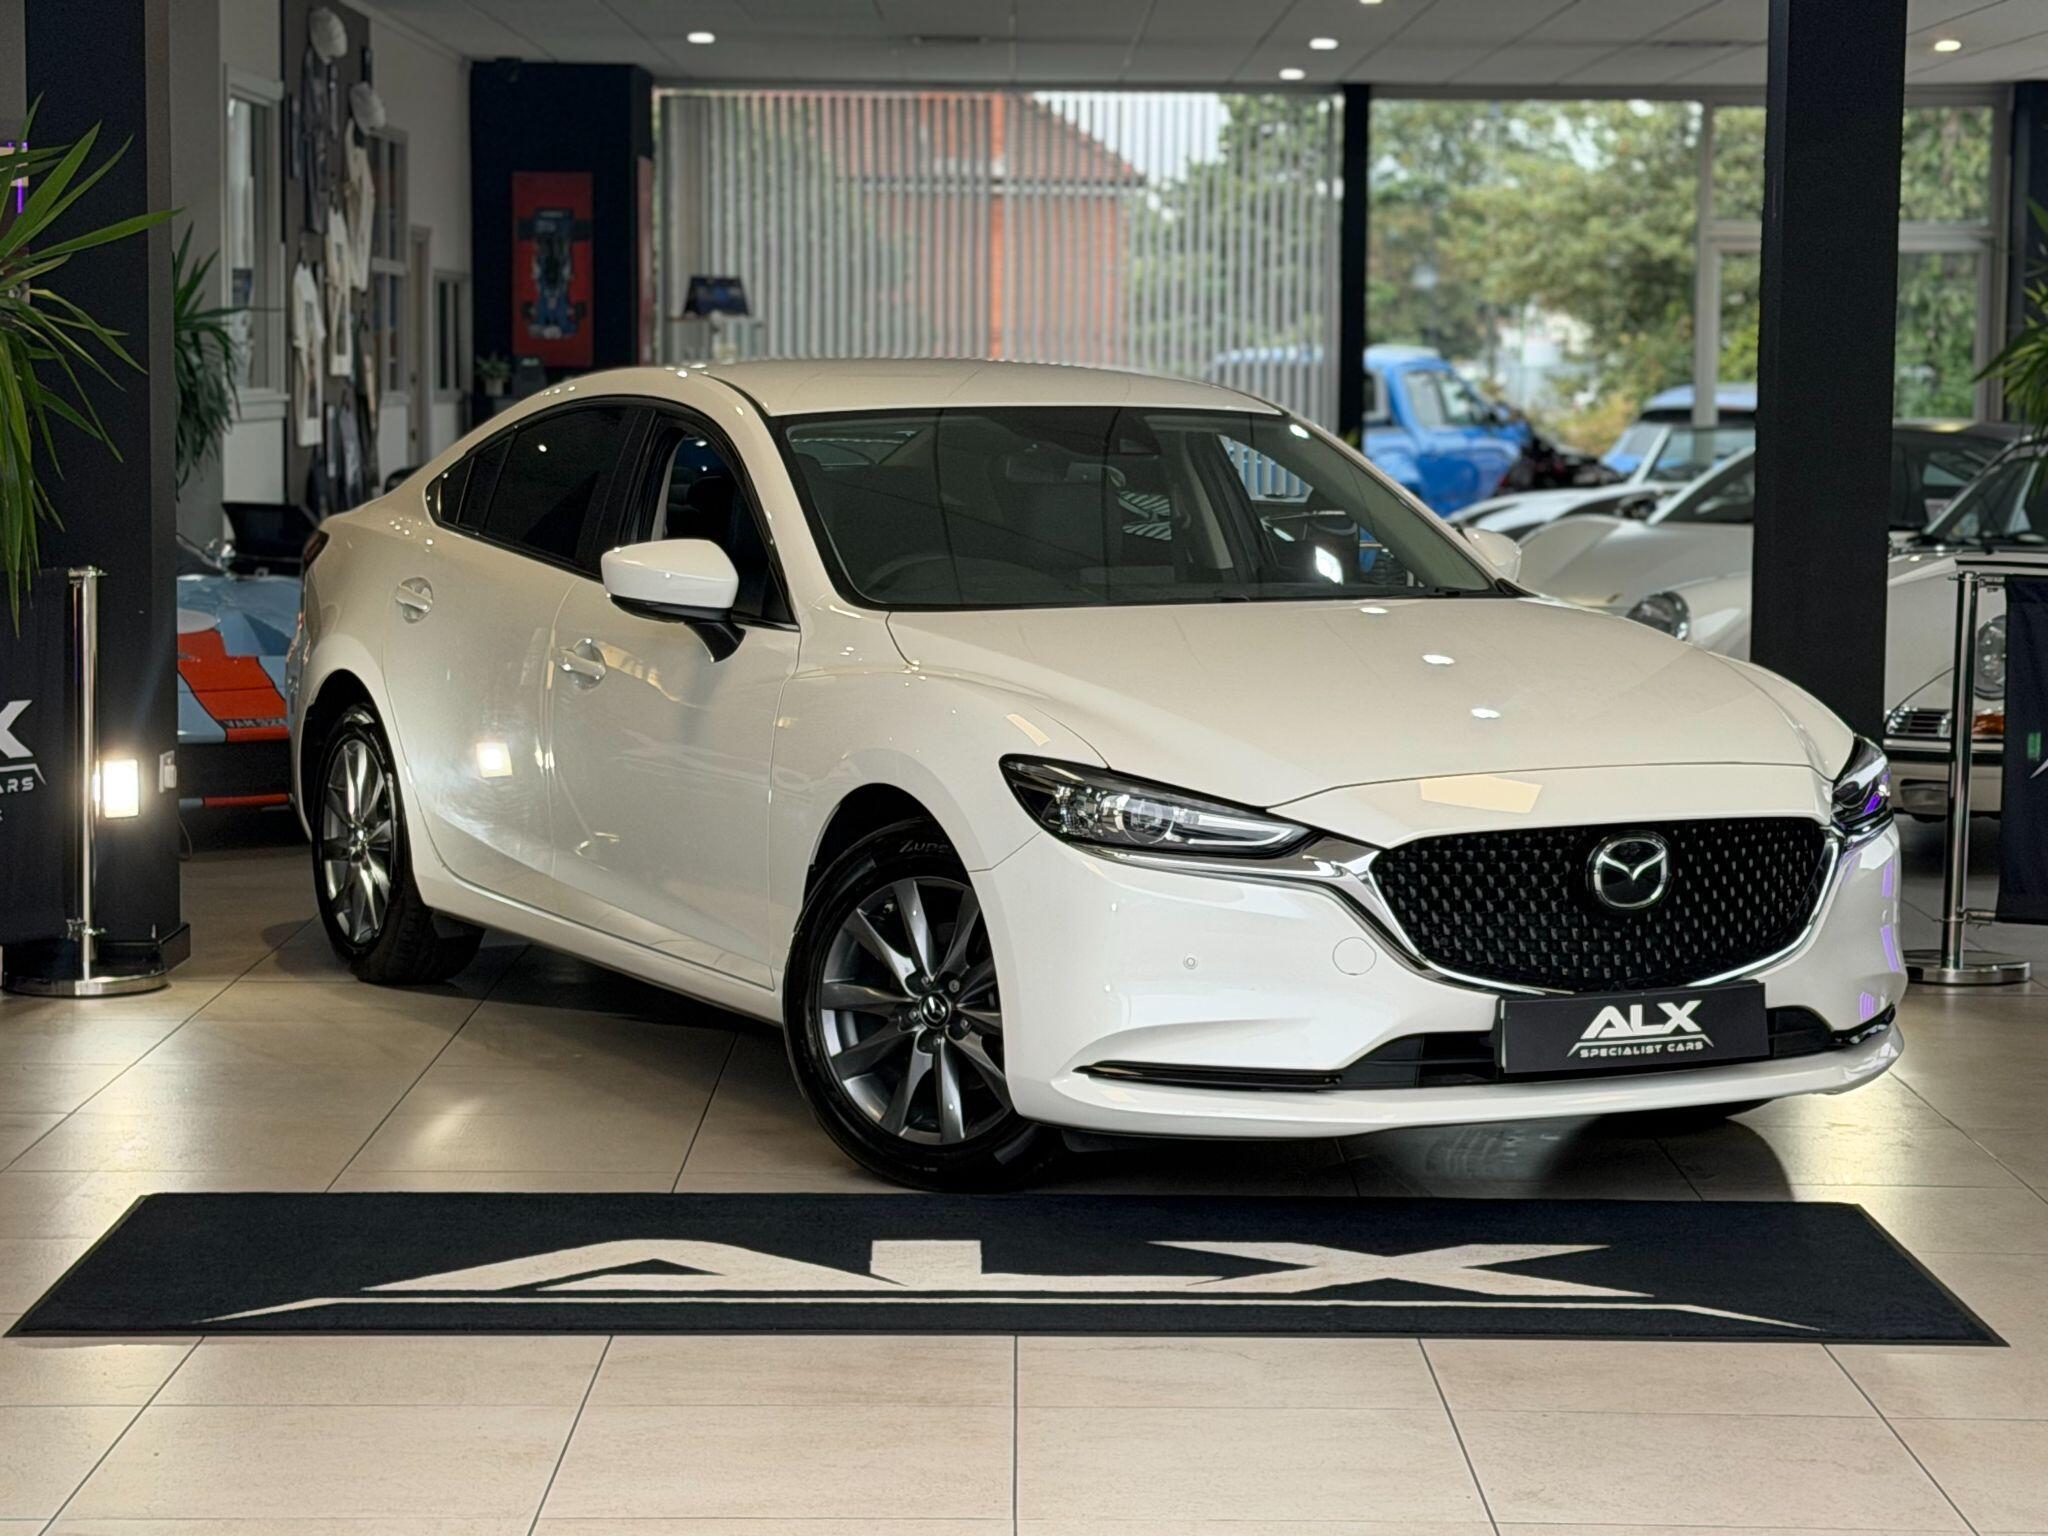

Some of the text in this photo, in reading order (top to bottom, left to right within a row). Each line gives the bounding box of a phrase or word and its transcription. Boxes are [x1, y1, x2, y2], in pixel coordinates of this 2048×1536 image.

[1579, 999, 1703, 1040] ALX
[1579, 1040, 1704, 1059] SPECIALIST CARS
[361, 1238, 1655, 1297] ALX
